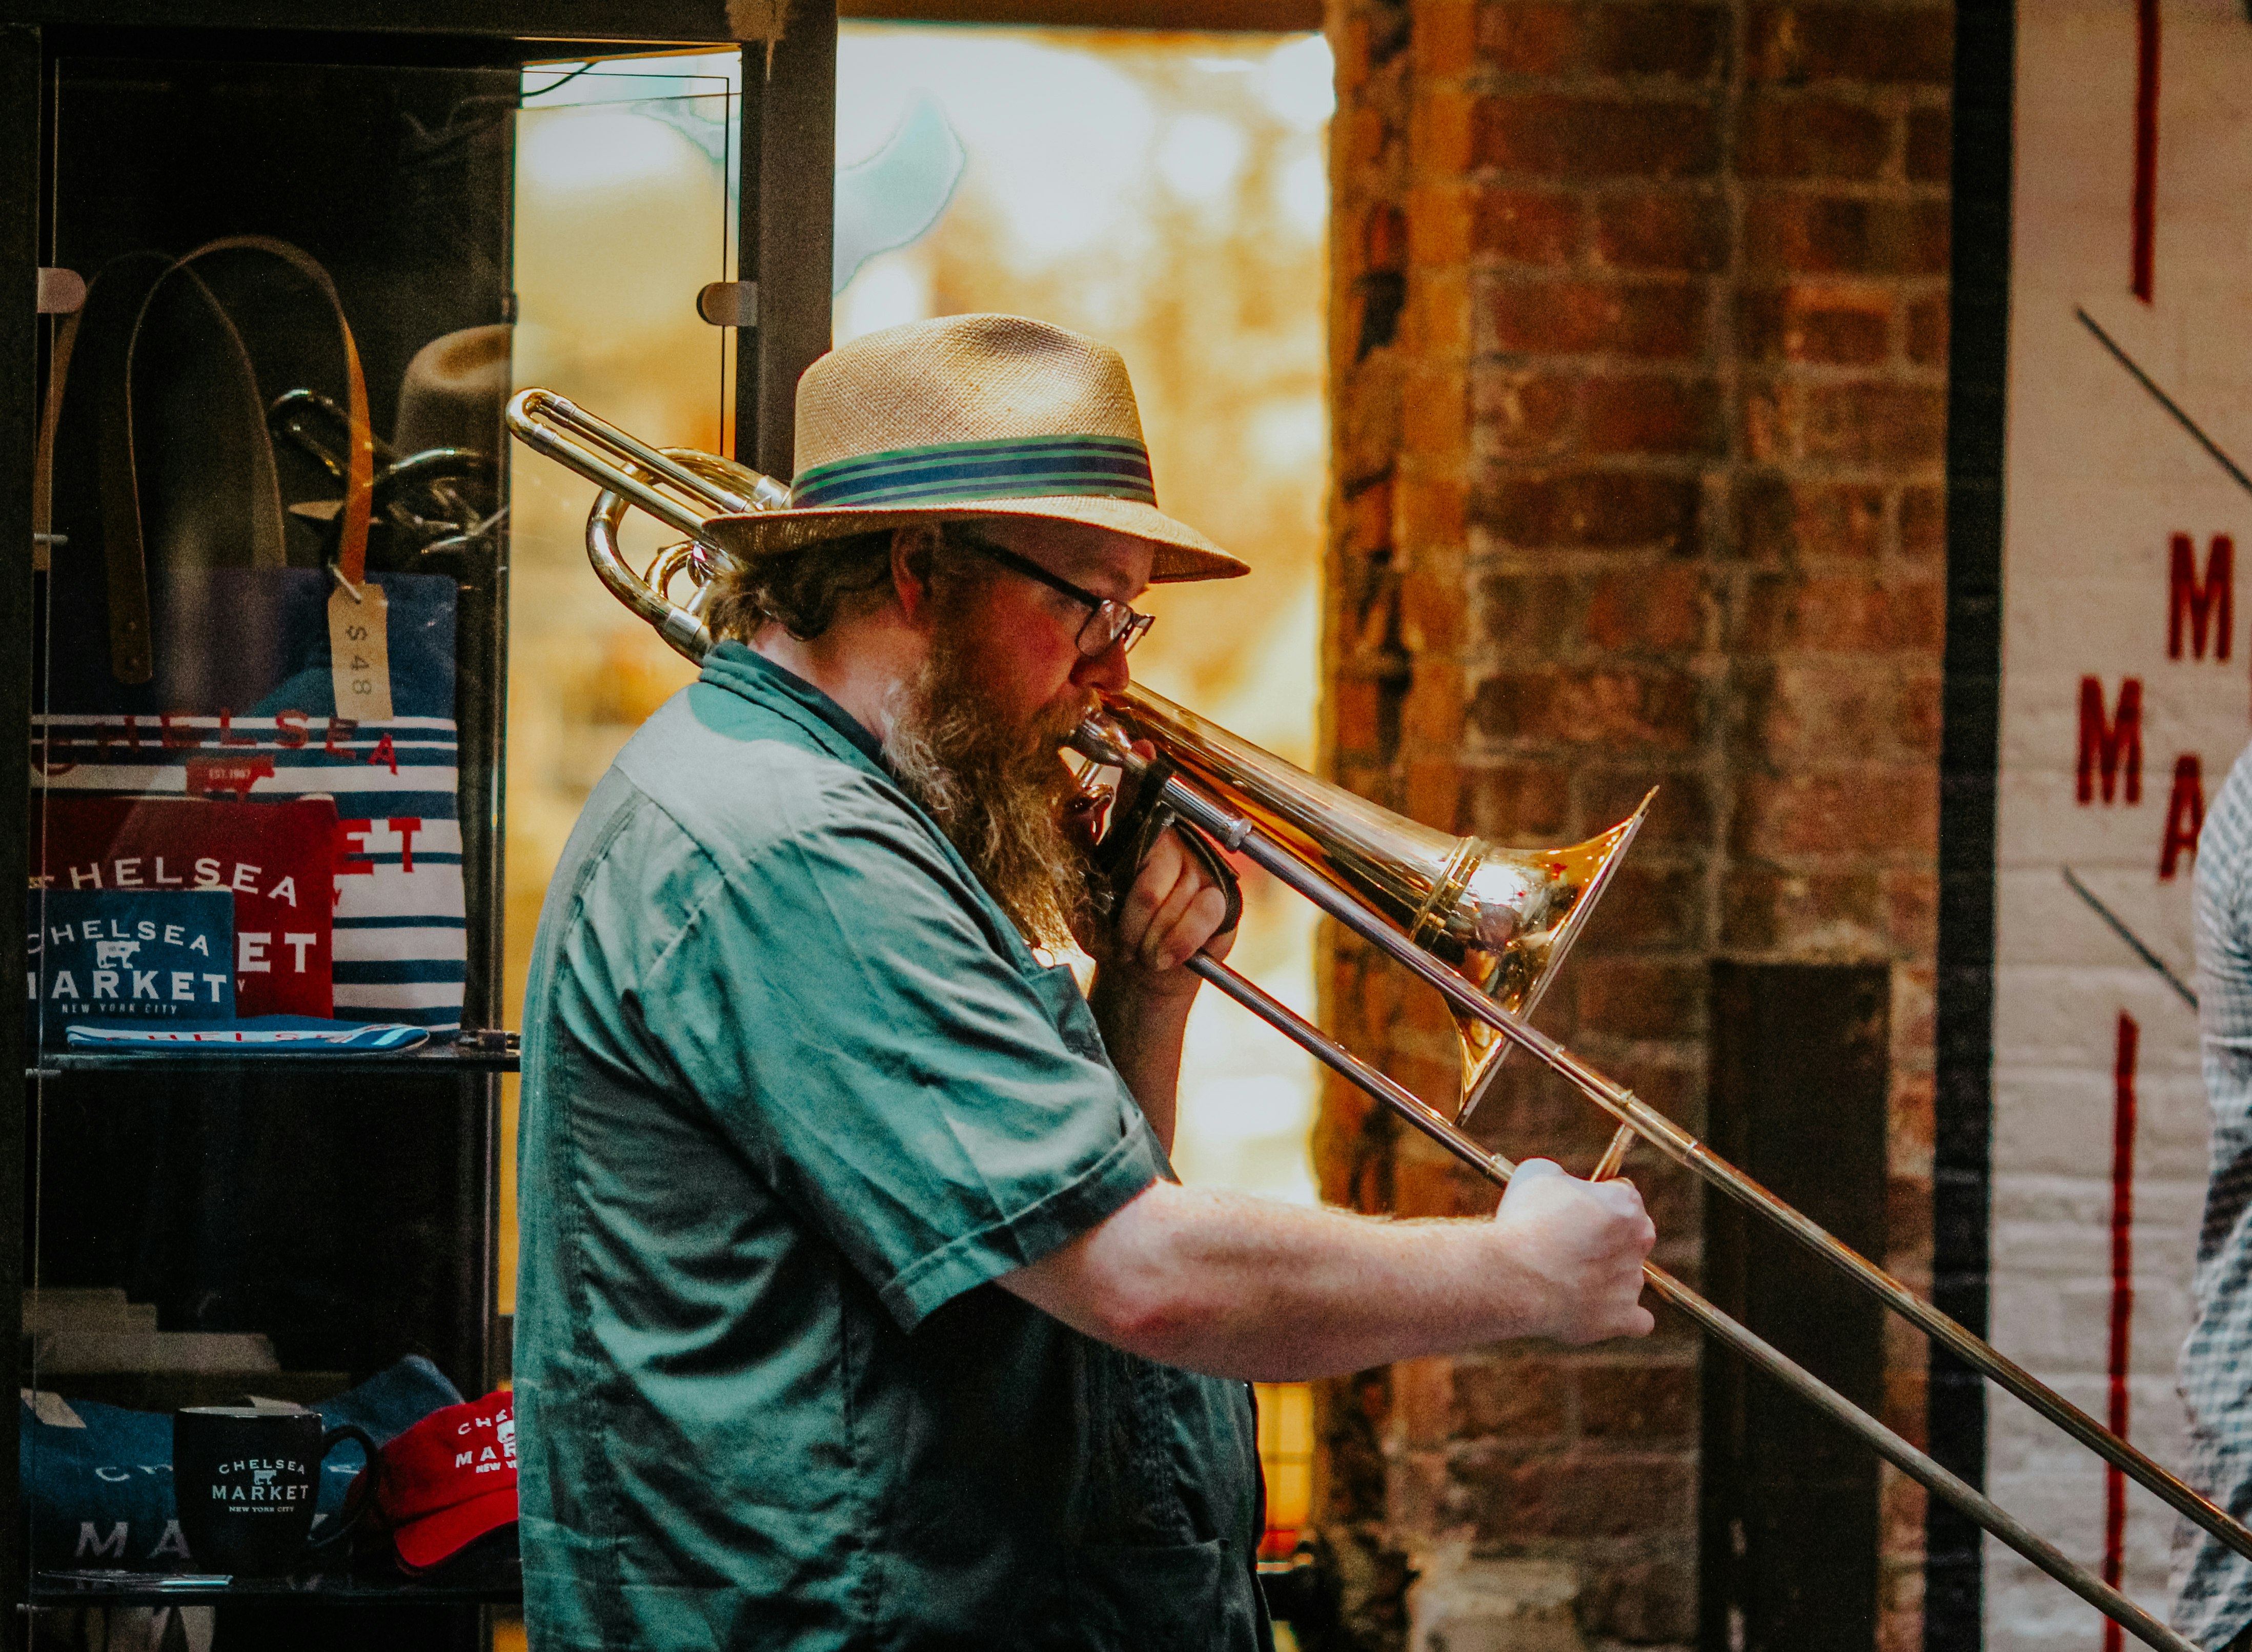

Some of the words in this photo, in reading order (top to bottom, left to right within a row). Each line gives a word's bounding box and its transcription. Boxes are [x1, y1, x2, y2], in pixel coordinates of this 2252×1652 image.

[29, 856, 297, 908] HELSEA
[145, 1003, 177, 1014] CITY
[218, 1459, 306, 1475] CHELSEA
[211, 1484, 309, 1501] MARKET
